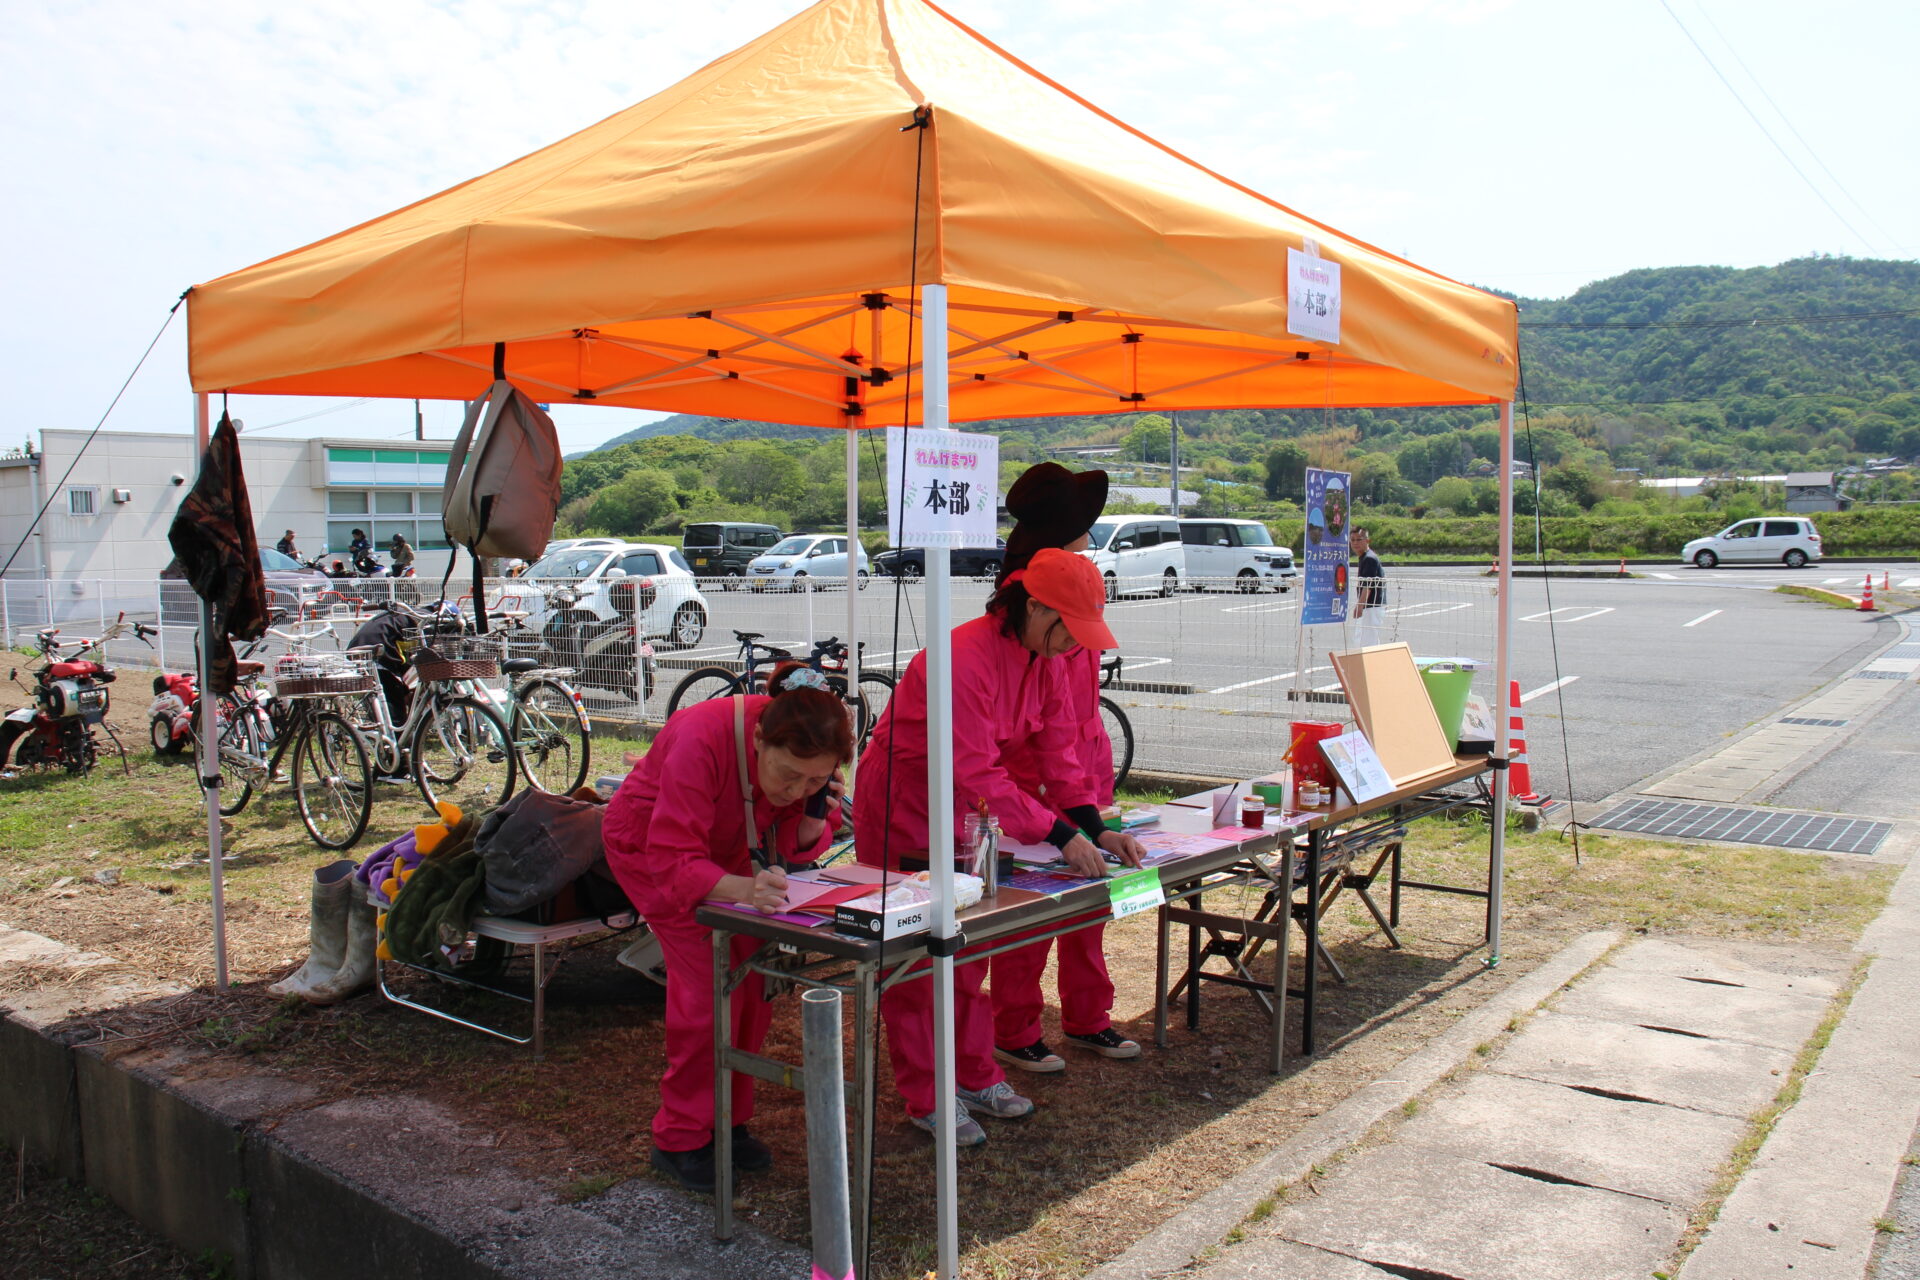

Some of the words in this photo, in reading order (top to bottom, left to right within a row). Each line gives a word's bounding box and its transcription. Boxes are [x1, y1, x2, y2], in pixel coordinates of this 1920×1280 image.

[1304, 288, 1327, 317] 本部
[916, 449, 977, 469] れんげまつり
[923, 479, 970, 515] 本部
[1307, 550, 1348, 561] フォトコンテスト
[837, 913, 855, 921] ENEOS
[897, 914, 922, 927] ENEOS
